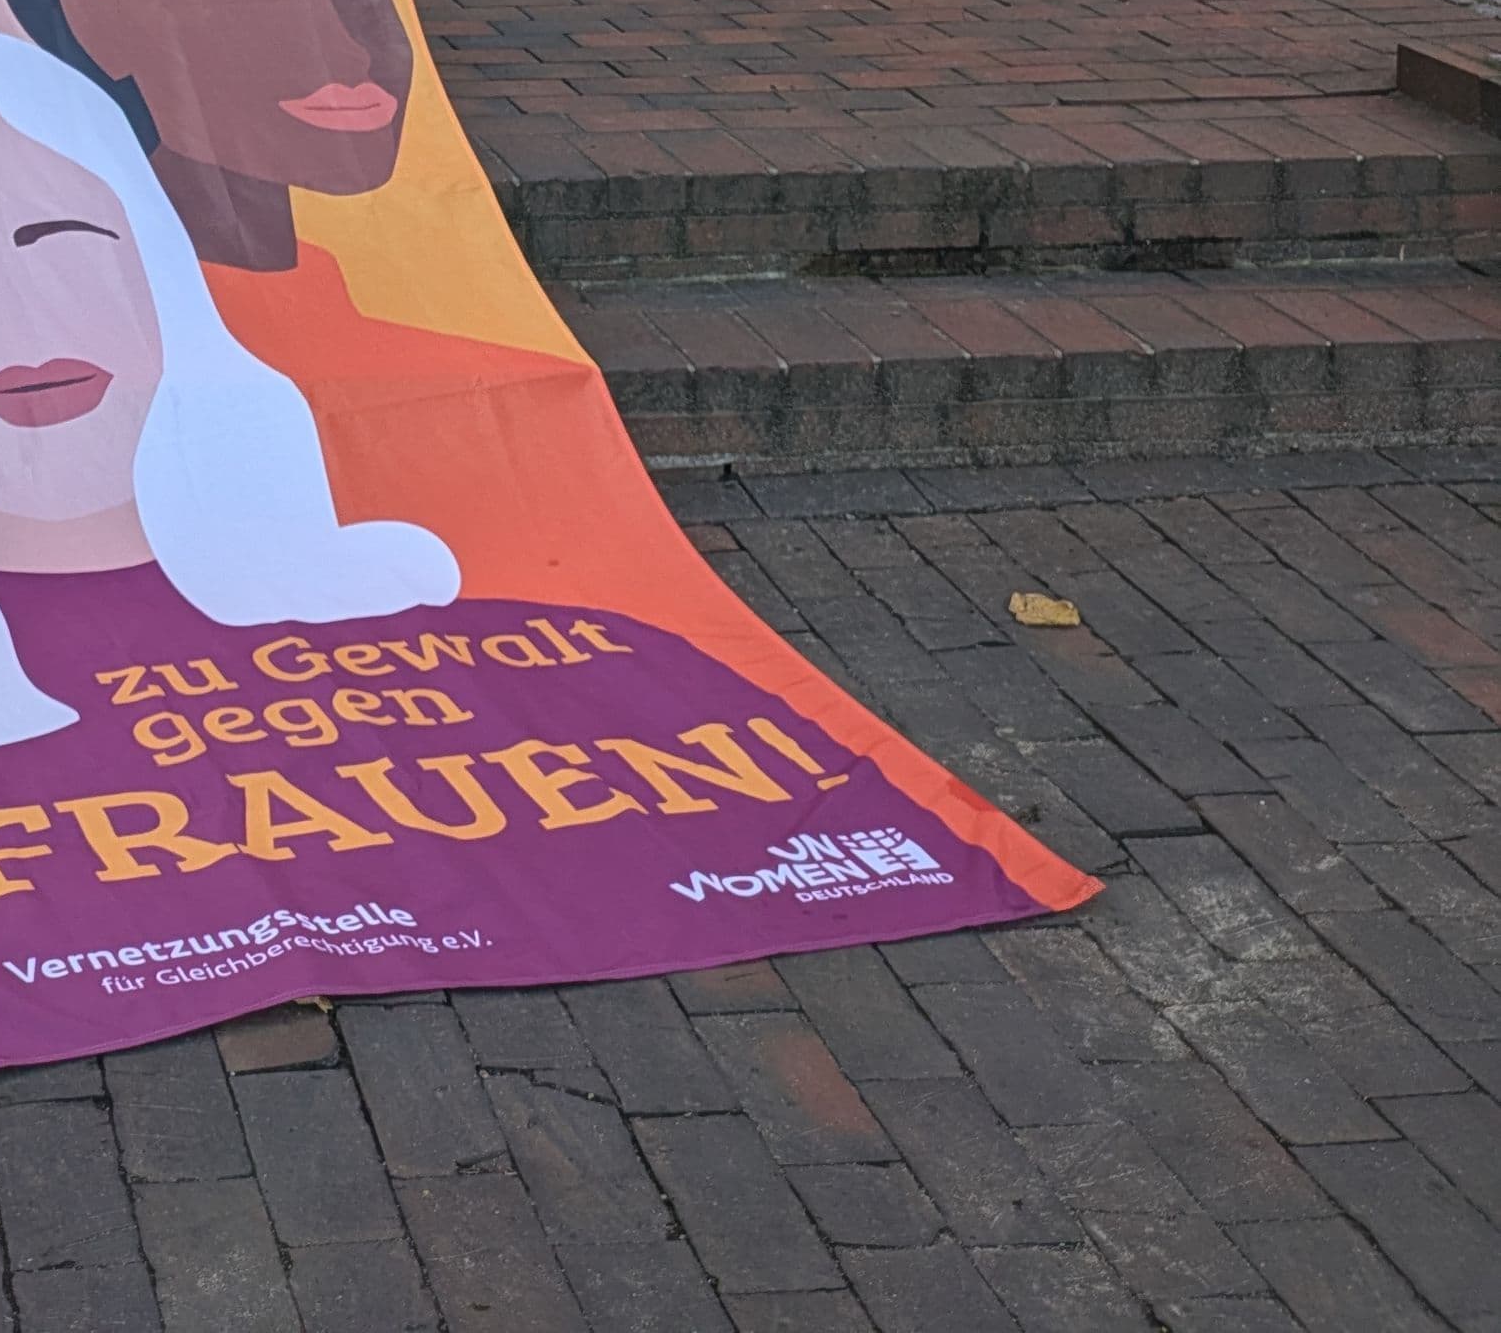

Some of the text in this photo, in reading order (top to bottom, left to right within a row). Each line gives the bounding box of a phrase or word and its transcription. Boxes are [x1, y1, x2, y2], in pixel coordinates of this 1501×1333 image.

[95, 618, 634, 705] zu Gewalt
[132, 687, 474, 766] gegen
[767, 833, 846, 861] UN
[669, 858, 871, 902] WOMEN
[795, 872, 955, 903] DEUTSCHLAND
[2, 902, 418, 984] Vernetzungsstelle
[100, 930, 493, 995] für Gleichberechtigung e.V.
